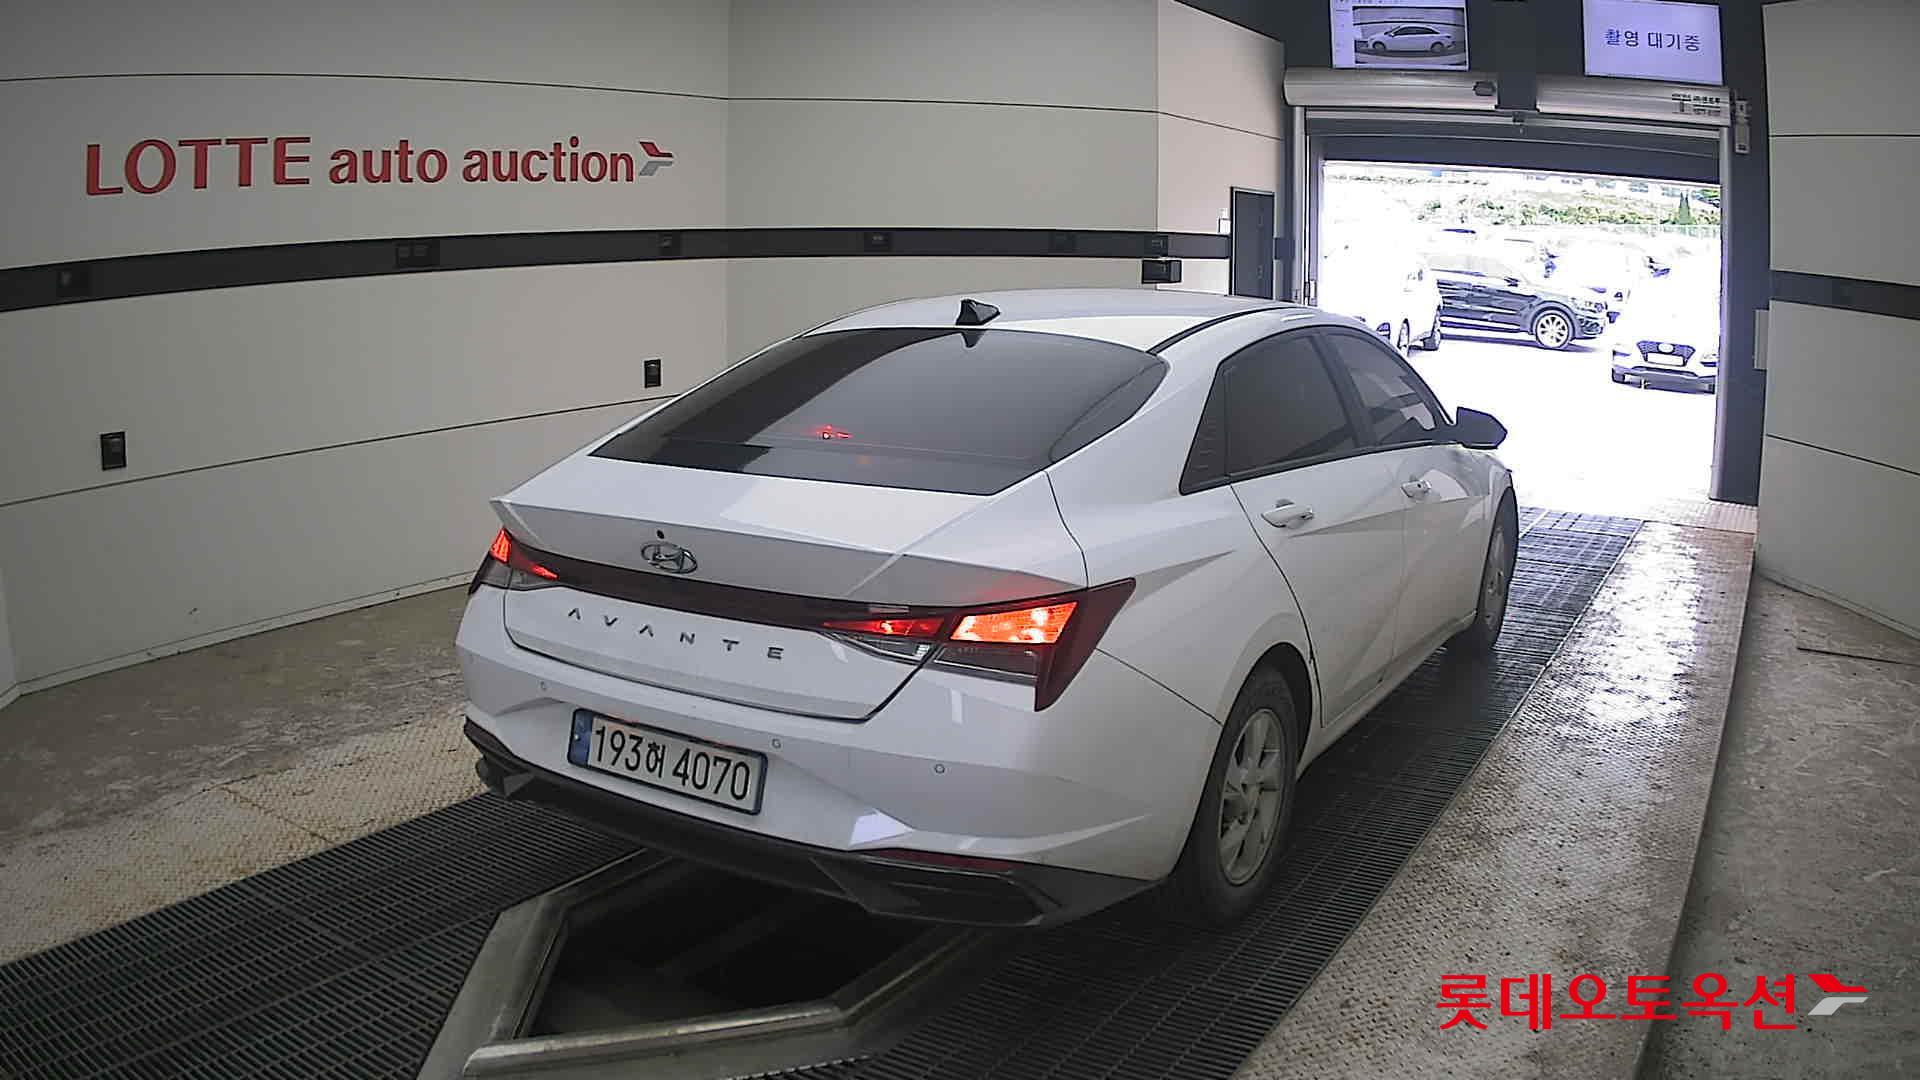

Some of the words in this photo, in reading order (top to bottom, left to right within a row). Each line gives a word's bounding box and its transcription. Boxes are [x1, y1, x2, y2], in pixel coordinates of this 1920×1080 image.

[1647, 31, 1701, 52] 대기중
[85, 136, 311, 196] LOTTE
[328, 139, 448, 184] auto
[462, 136, 635, 184] auction
[567, 607, 784, 660] AVANTE
[594, 725, 666, 779] 193허
[672, 747, 751, 801] 4070
